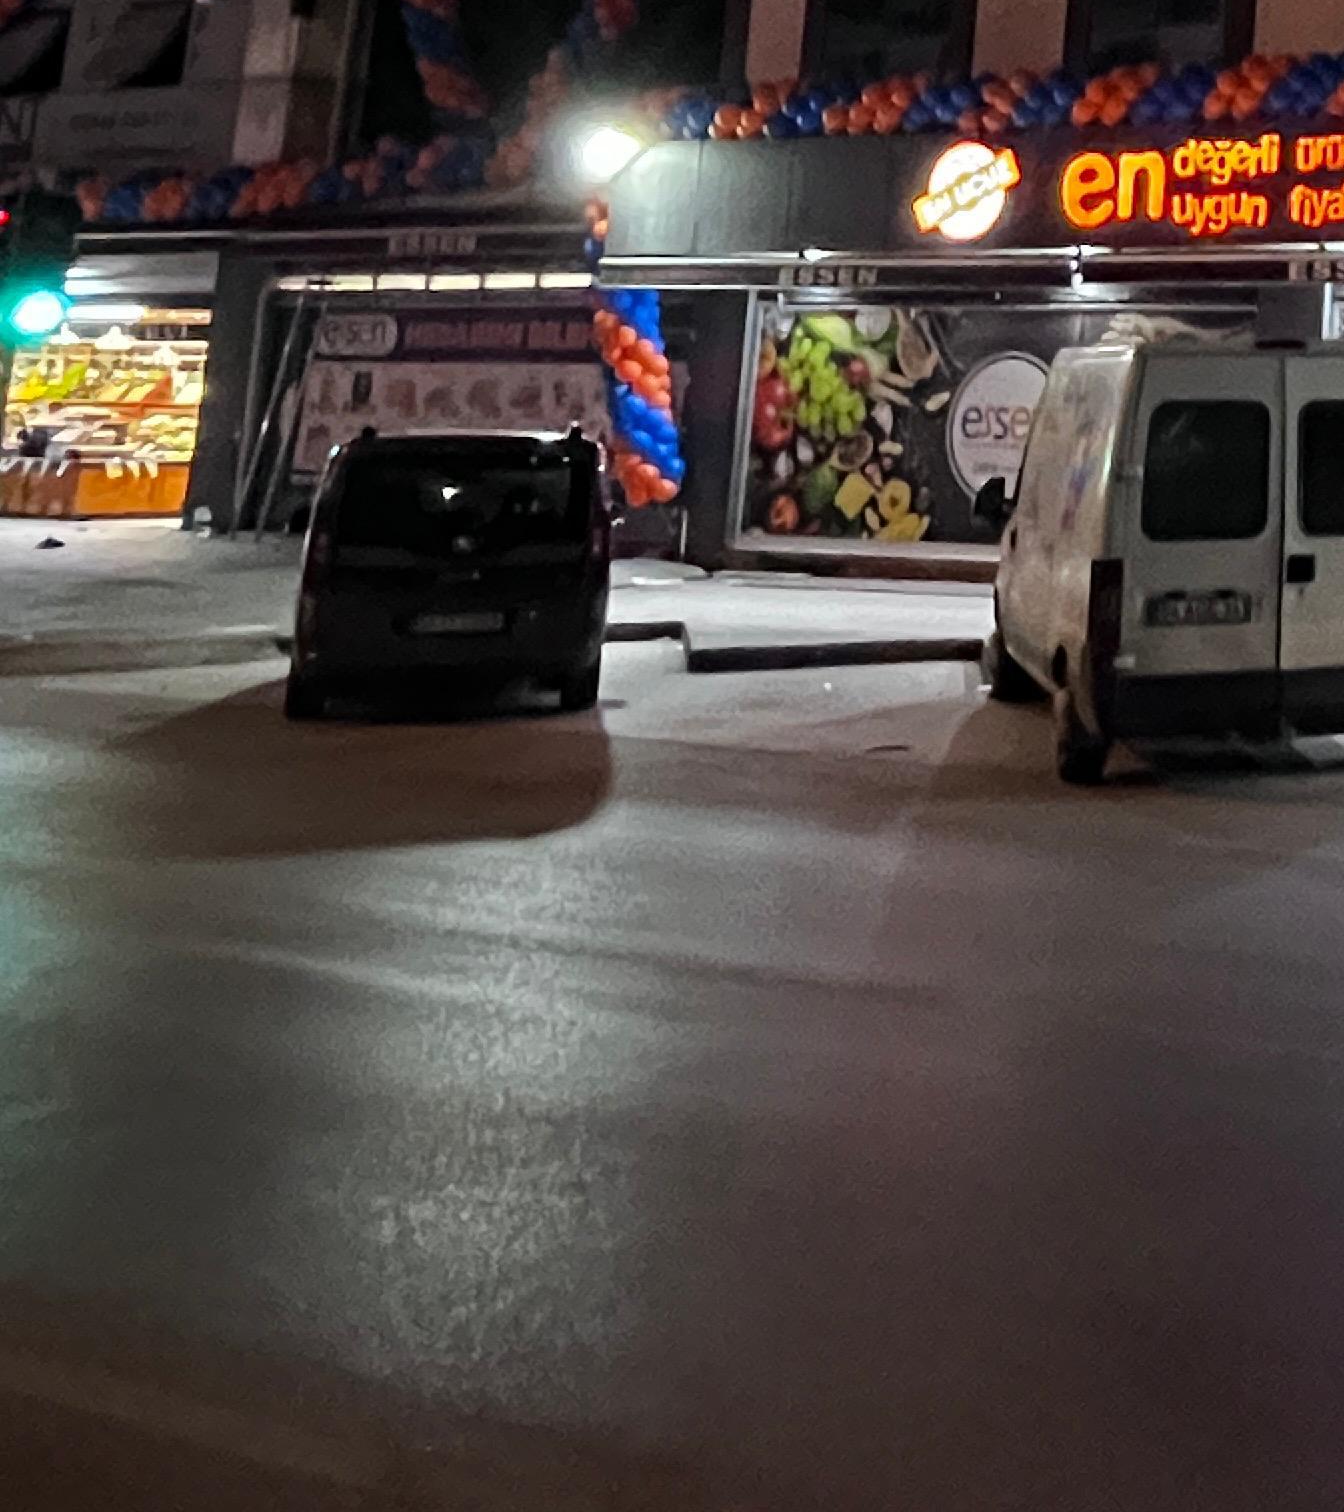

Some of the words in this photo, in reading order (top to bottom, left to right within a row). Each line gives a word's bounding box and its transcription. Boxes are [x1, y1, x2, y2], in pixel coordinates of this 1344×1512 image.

[1172, 133, 1281, 186] değerli
[1062, 150, 1166, 228] en
[1172, 190, 1268, 236] uygun
[779, 265, 877, 287] ESSEN
[962, 405, 1031, 440] esse
